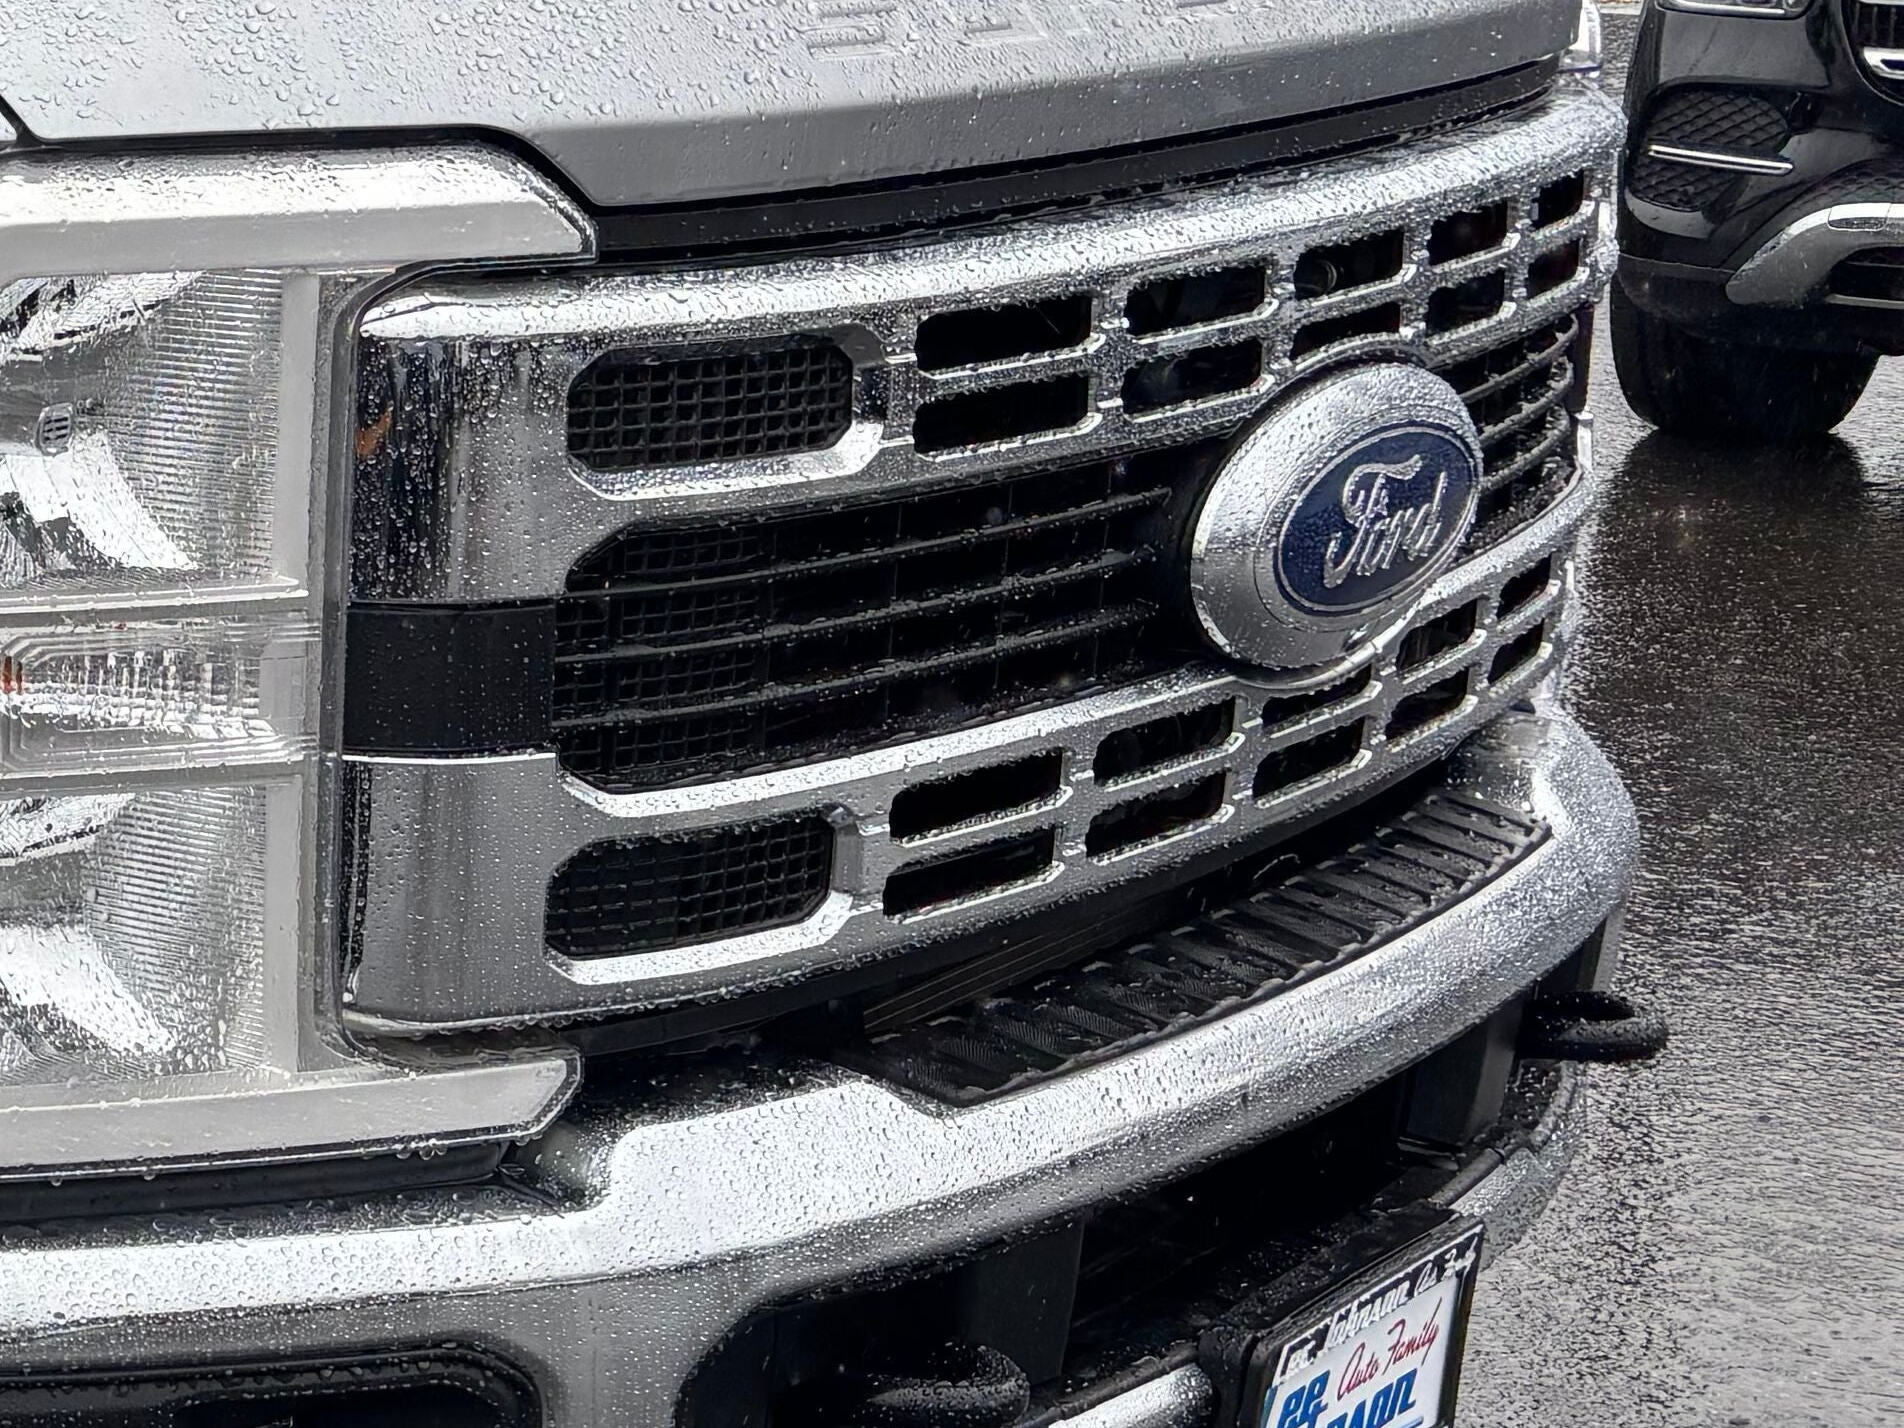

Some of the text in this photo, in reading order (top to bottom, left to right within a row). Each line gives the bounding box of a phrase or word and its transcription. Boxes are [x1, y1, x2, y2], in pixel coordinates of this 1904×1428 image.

[1323, 454, 1447, 590] Ford
[1337, 1342, 1380, 1402] Auto
[1382, 1296, 1443, 1376] Family
